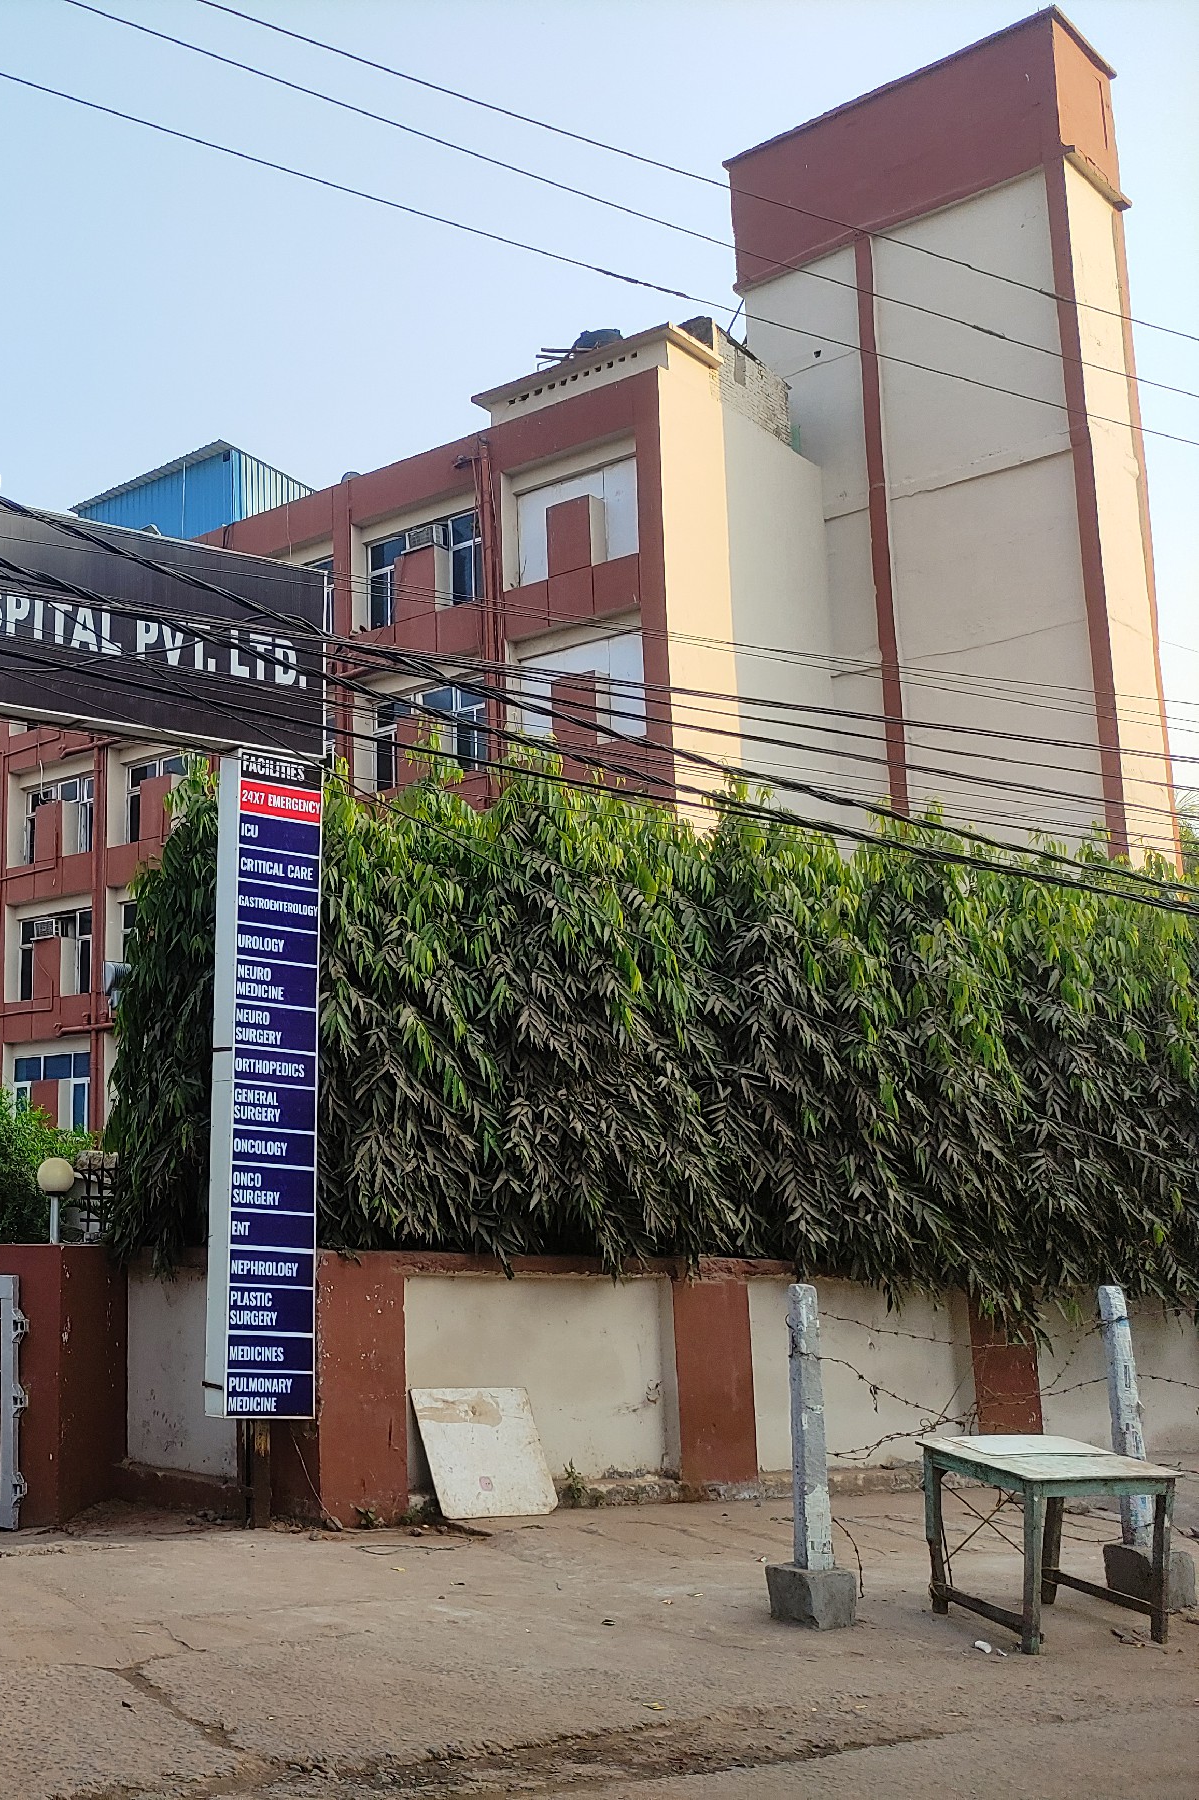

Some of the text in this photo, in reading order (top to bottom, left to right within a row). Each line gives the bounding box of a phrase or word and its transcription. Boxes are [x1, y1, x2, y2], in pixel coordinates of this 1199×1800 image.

[136, 619, 217, 672] PVT.
[230, 629, 307, 690] LTD.
[242, 754, 305, 782] FACILITIES
[241, 789, 321, 814] 24X7 EMERGENCY
[241, 822, 259, 838] ICU
[240, 856, 313, 881] CRITICAL CARE
[238, 895, 318, 917] GASTROENTEROLOGY
[237, 933, 284, 953] UROLOGY
[237, 964, 271, 981] NEURO
[236, 981, 284, 1000] MEDICINE
[235, 1009, 270, 1026] NEURO
[235, 1027, 282, 1045] SURGERY
[235, 1057, 305, 1078] ORTHOPEDICS
[234, 1088, 279, 1106] GENERAL
[233, 1105, 281, 1123] SURGERY
[233, 1137, 288, 1157] ONCOLOGY
[232, 1171, 262, 1187] ONCO
[232, 1189, 280, 1206] SURGERY
[231, 1221, 251, 1236] ENT
[230, 1259, 299, 1277] NEPHROLOGY
[230, 1290, 272, 1307] PLASTIC
[229, 1309, 278, 1326] SURGERY
[229, 1345, 284, 1362] MEDICINES
[228, 1376, 293, 1394] PULMONARY
[227, 1396, 277, 1413] MEDICINE
